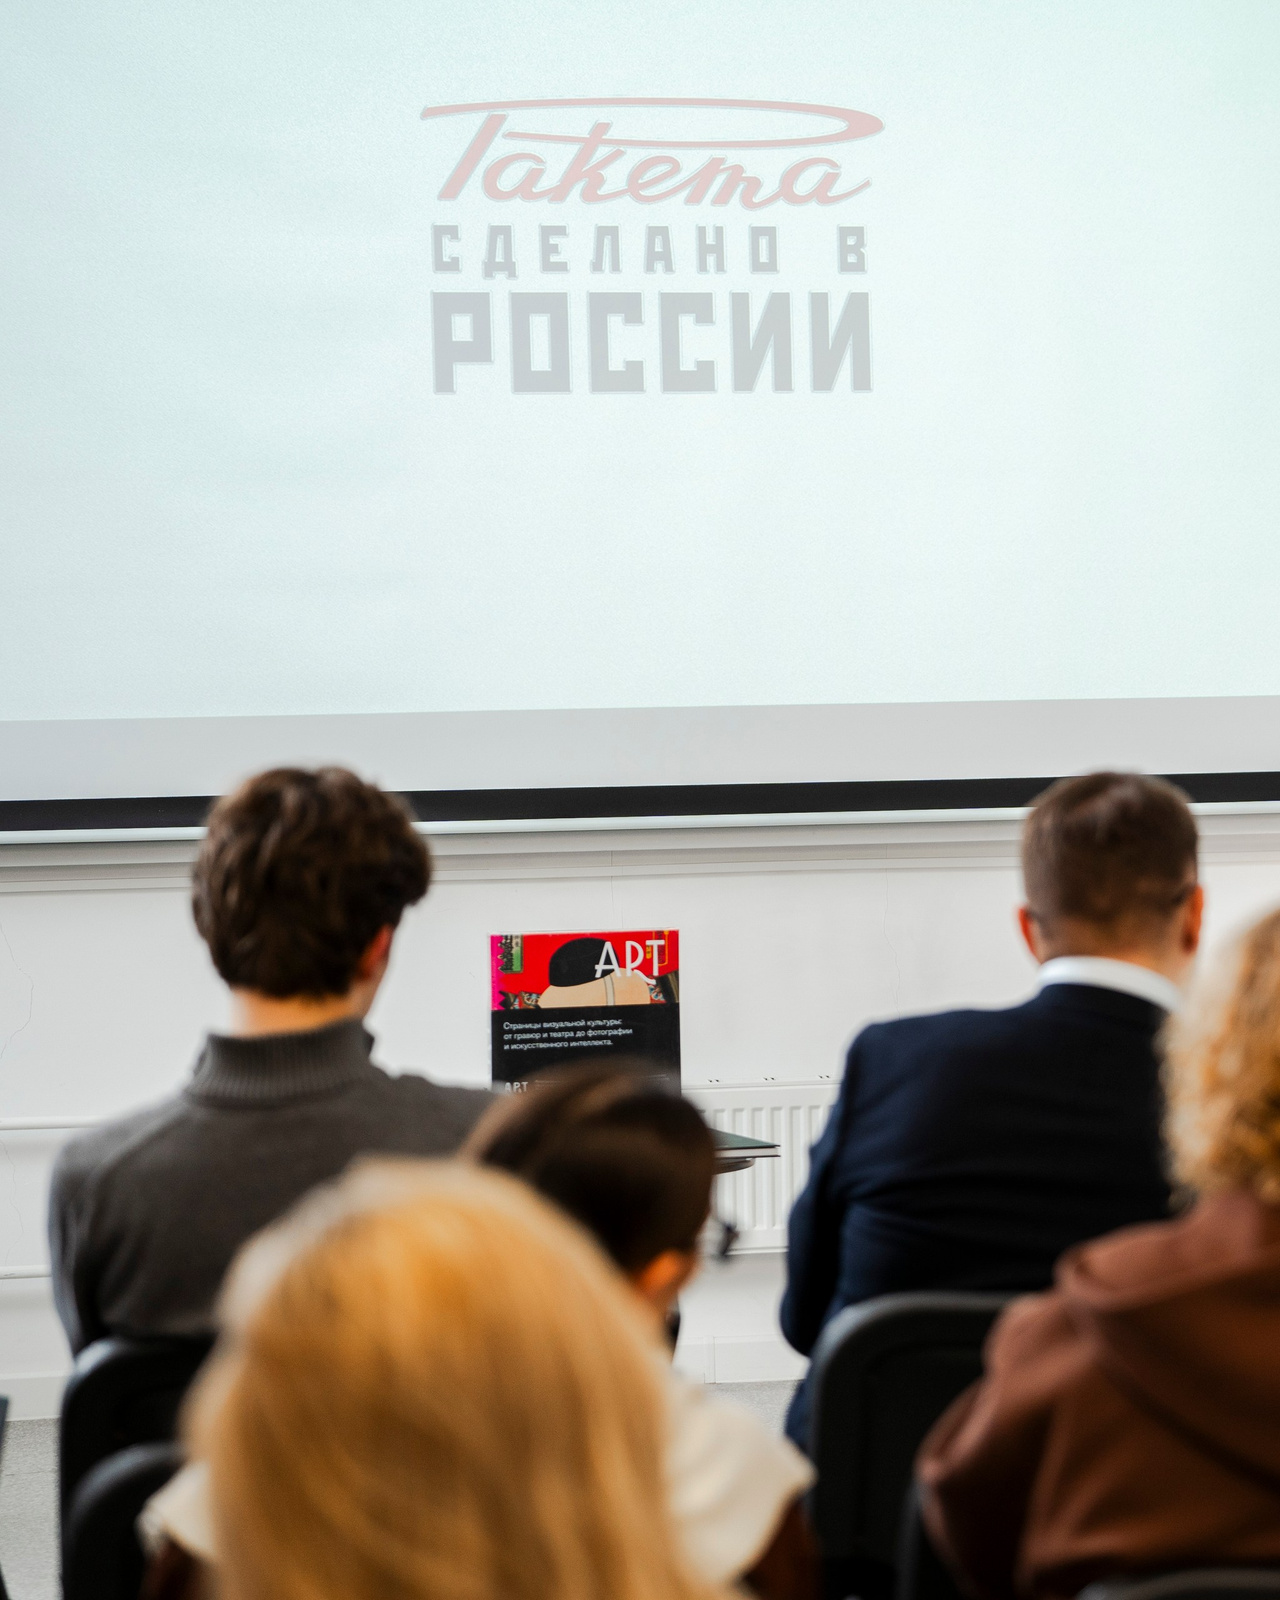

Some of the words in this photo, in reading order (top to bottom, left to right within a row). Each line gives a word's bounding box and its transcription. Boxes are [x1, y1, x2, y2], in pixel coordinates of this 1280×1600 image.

[432, 224, 779, 279] СДЕЛАНО
[838, 224, 868, 273] В
[431, 290, 873, 394] РОССИИ
[594, 939, 665, 985] ART
[503, 1021, 541, 1031] Страницы
[543, 1019, 586, 1029] визуальной
[514, 1032, 541, 1040] гравюр
[587, 1027, 633, 1037] фотографии
[511, 1040, 568, 1050] искусственного
